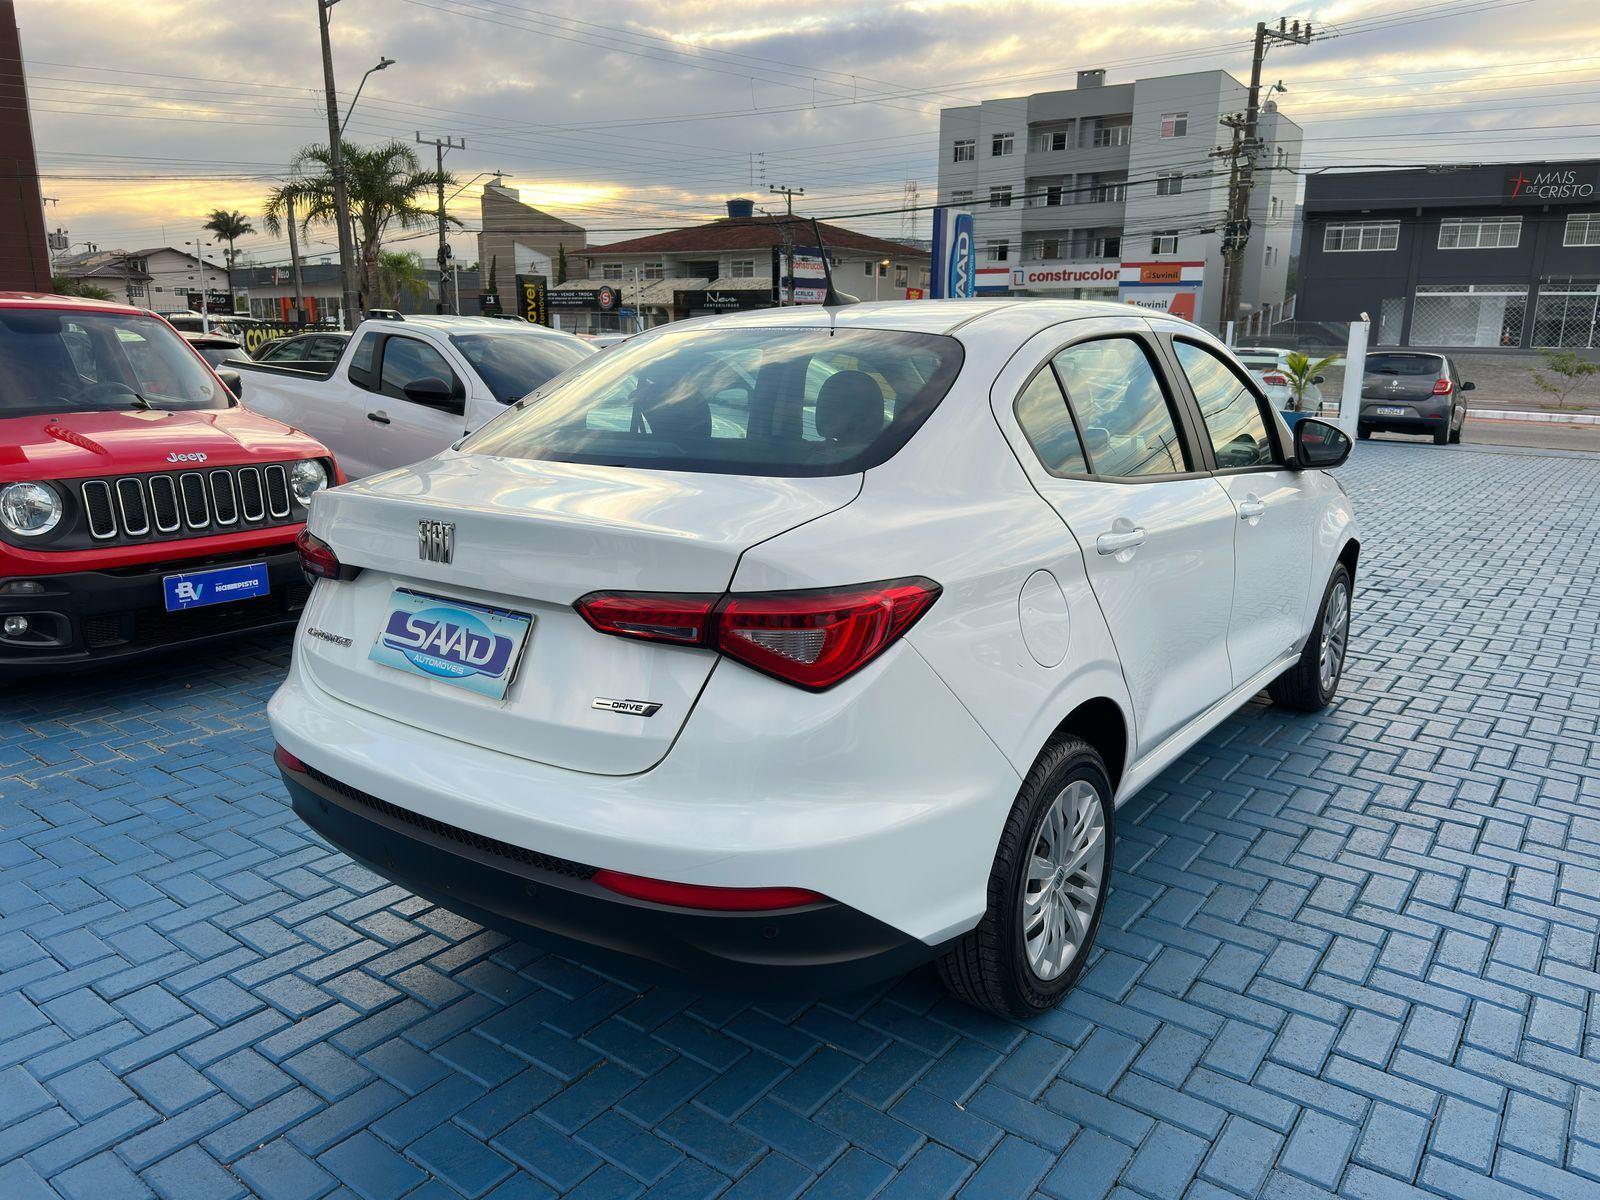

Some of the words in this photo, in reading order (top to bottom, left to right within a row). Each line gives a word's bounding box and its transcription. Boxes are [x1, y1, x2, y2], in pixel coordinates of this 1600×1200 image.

[1534, 171, 1576, 185] MAIS
[1538, 184, 1593, 198] CRISTO
[955, 232, 969, 299] AAD
[1028, 268, 1120, 283] construcolor
[1136, 300, 1168, 308] Suvinil
[166, 452, 208, 463] Jeep
[418, 519, 456, 564] FIAT
[404, 618, 497, 667] SAAD
[611, 701, 644, 712] DRIVE
